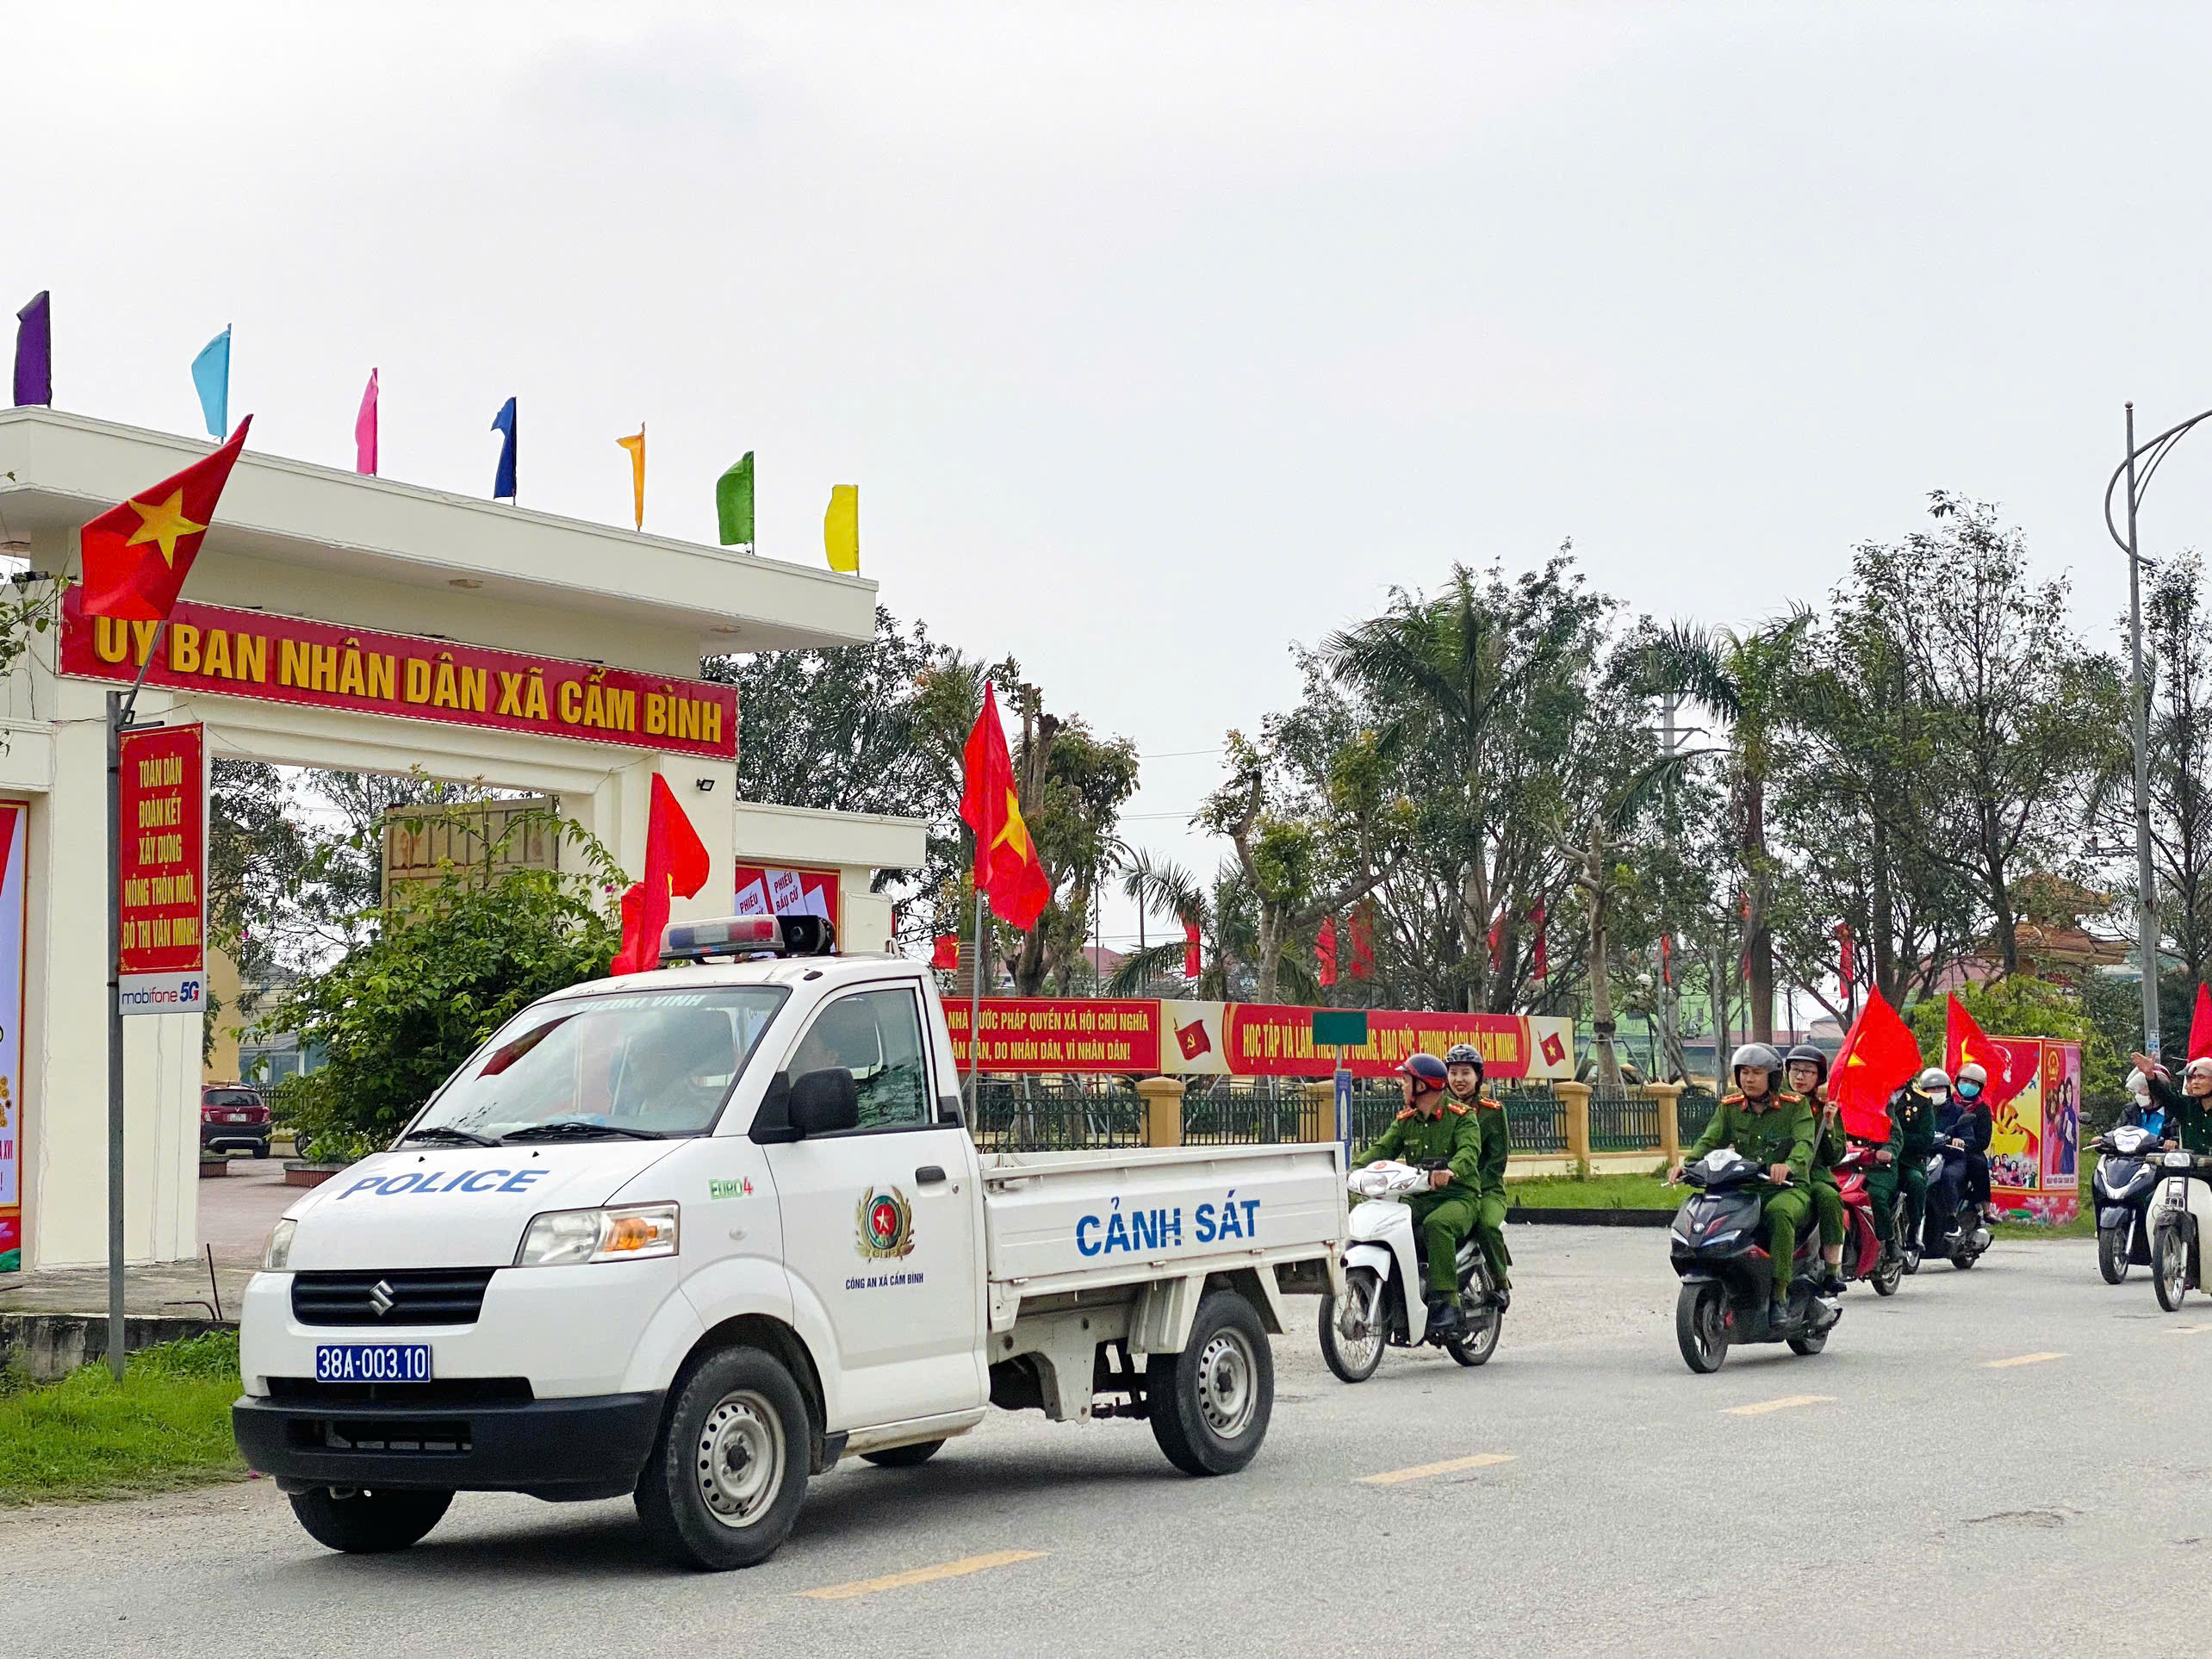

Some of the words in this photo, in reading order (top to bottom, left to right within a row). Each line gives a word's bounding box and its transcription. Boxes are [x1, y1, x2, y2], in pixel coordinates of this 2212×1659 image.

[170, 623, 266, 683] BAN
[278, 637, 395, 699] NHÂN
[406, 652, 487, 712] DÂN
[496, 667, 549, 721] XÃ
[558, 667, 635, 731] CẨM
[644, 685, 721, 743] BÌNH
[139, 754, 162, 788] TOÀN
[164, 751, 182, 786] DÂN
[139, 793, 163, 828] ĐOÀN
[165, 787, 182, 825] KẾT
[139, 830, 156, 865] XÂY
[158, 832, 182, 869] DỰNG
[125, 873, 149, 907] NÔNG
[152, 871, 174, 905] THÔN
[177, 867, 196, 906] MỚI,
[123, 915, 135, 949] ĐÔ
[138, 920, 151, 954] THỊ
[152, 913, 171, 947] VĂN
[173, 917, 199, 946] MINH!
[122, 986, 177, 1005] mobifone
[180, 981, 199, 1003] 5G
[650, 995, 707, 1007] VINH
[948, 1008, 968, 1029] NHÀ
[972, 1009, 998, 1029] ƯỚC
[1001, 1009, 1027, 1029] PHÁP
[1029, 1007, 1060, 1032] QUYỀN
[1064, 1010, 1077, 1030] XÃ
[1079, 1010, 1096, 1034] HỘI
[1098, 1007, 1117, 1030] CHỦ
[1120, 1010, 1148, 1031] NGHĨA
[995, 1041, 1007, 1059] DO
[1010, 1038, 1038, 1059] NHÂN
[1041, 1039, 1064, 1061] DÂN,
[1066, 1040, 1075, 1059] VÌ
[1078, 1039, 1104, 1060] NHÂN
[1107, 1039, 1130, 1060] DÂN!
[1243, 1024, 1261, 1065] HỌC
[1264, 1018, 1280, 1065] TẬP
[1283, 1018, 1294, 1058] VÀ
[1296, 1019, 1314, 1059] LÀM
[336, 1170, 550, 1200] POLICE
[1076, 1196, 1181, 1256] CẢNH
[1196, 1189, 1261, 1242] SÁT
[846, 1277, 865, 1289] CÔNG
[867, 1277, 877, 1288] AN
[879, 1274, 888, 1287] XÃ
[907, 1272, 923, 1284] BÌNH
[319, 1348, 426, 1378] 38A-003.10
